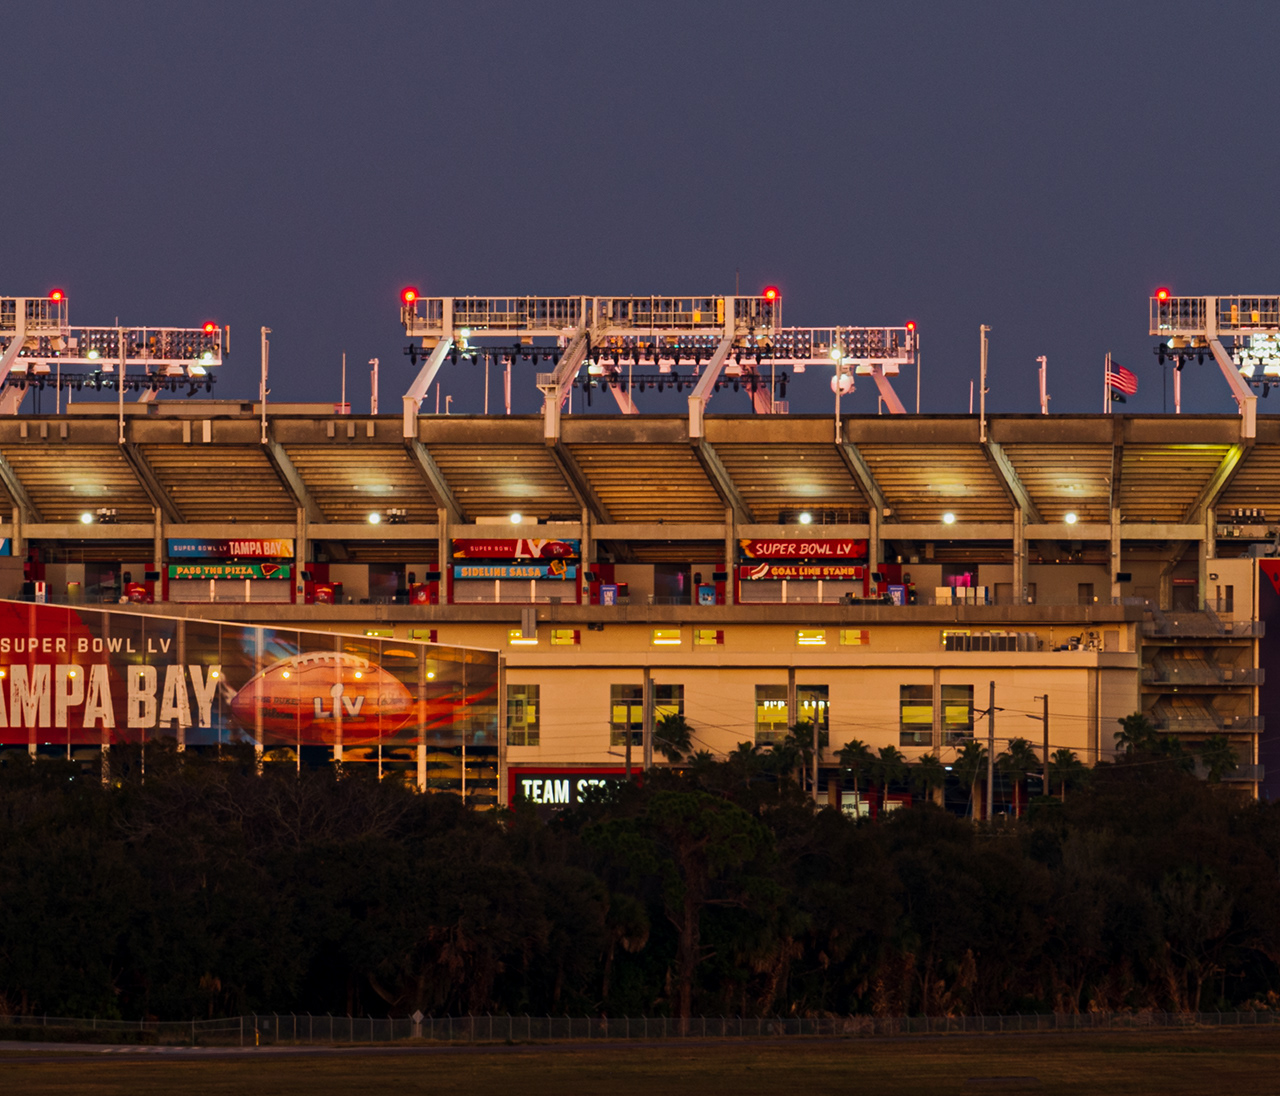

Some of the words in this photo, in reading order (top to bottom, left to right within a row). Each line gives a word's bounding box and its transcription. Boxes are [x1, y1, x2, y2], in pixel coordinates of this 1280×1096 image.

[229, 541, 262, 555] TAMPA
[263, 541, 282, 555] BAY
[514, 539, 546, 558] LV
[755, 543, 796, 555] SUPER
[799, 543, 833, 555] BOWL
[836, 543, 852, 554] LV
[176, 566, 202, 574] PASS
[204, 566, 224, 574] THE
[225, 566, 253, 574] PIZZA
[461, 567, 507, 577] SIDELINE
[509, 567, 541, 577] SALSA
[771, 567, 797, 576] GOAL
[799, 567, 821, 576] LINE
[823, 567, 855, 576] STAND
[0, 638, 67, 653] SUPER
[77, 638, 136, 653] BOWL
[148, 638, 171, 653] LV
[127, 664, 222, 728] BAY
[522, 779, 570, 804] TEAM
